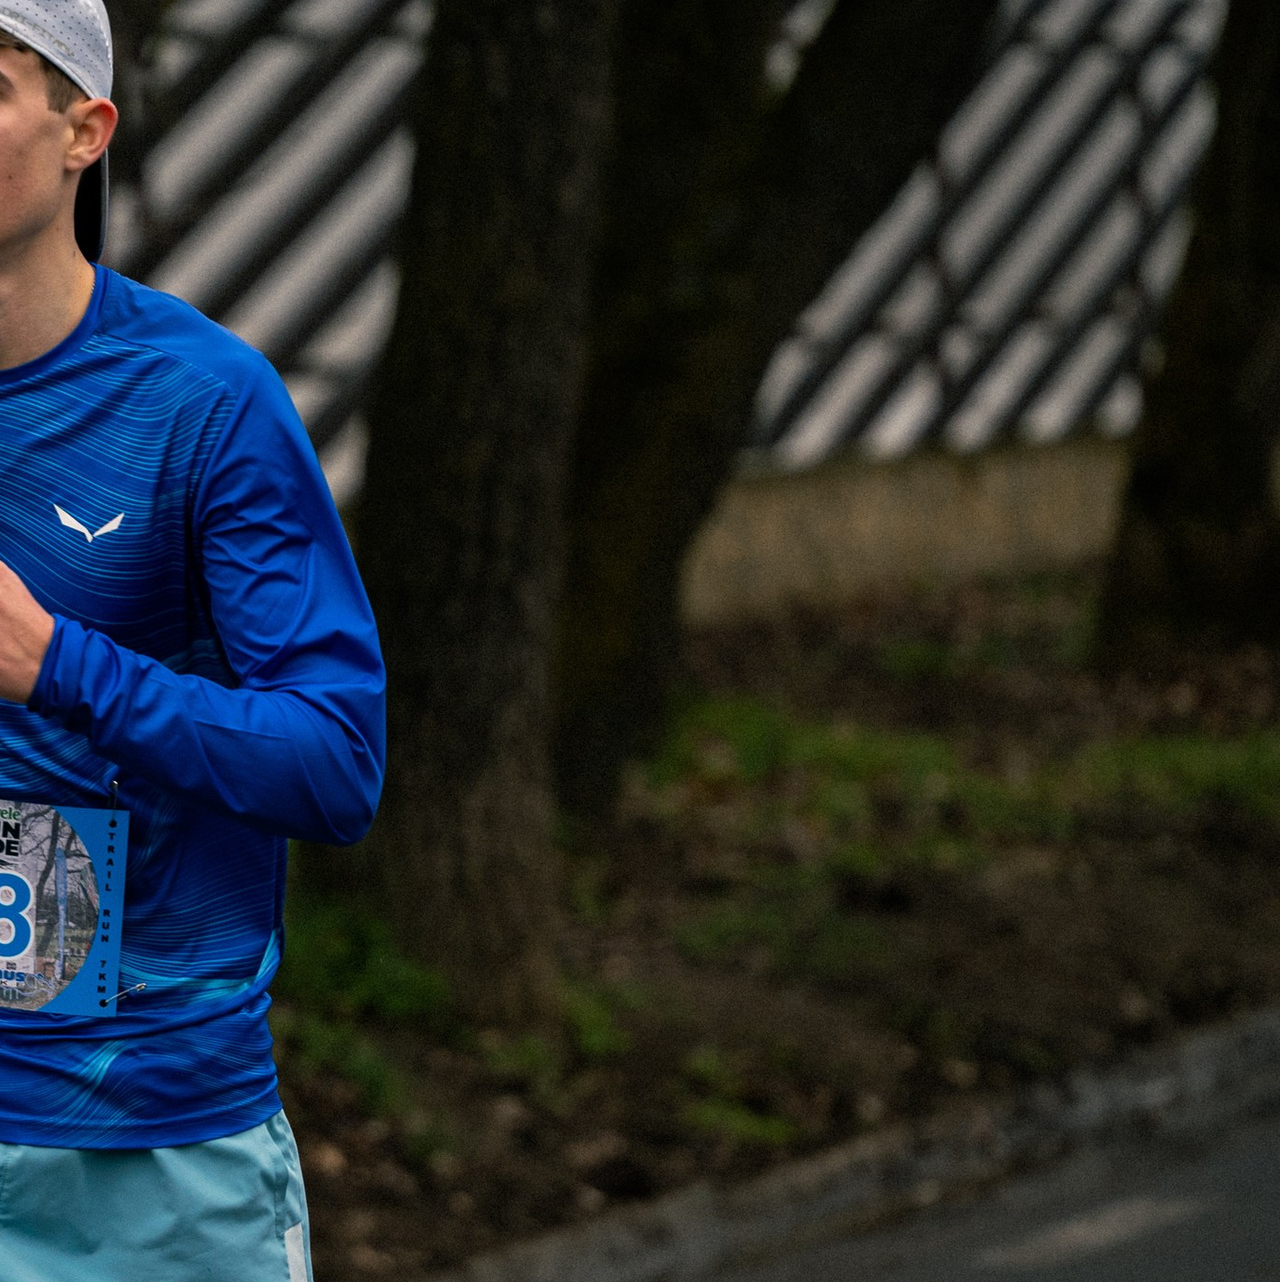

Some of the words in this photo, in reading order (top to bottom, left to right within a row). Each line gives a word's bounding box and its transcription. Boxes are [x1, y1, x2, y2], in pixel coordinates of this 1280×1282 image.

[105, 833, 116, 892] TRAIL
[100, 909, 111, 943] RUN
[97, 960, 107, 993] 7KM
